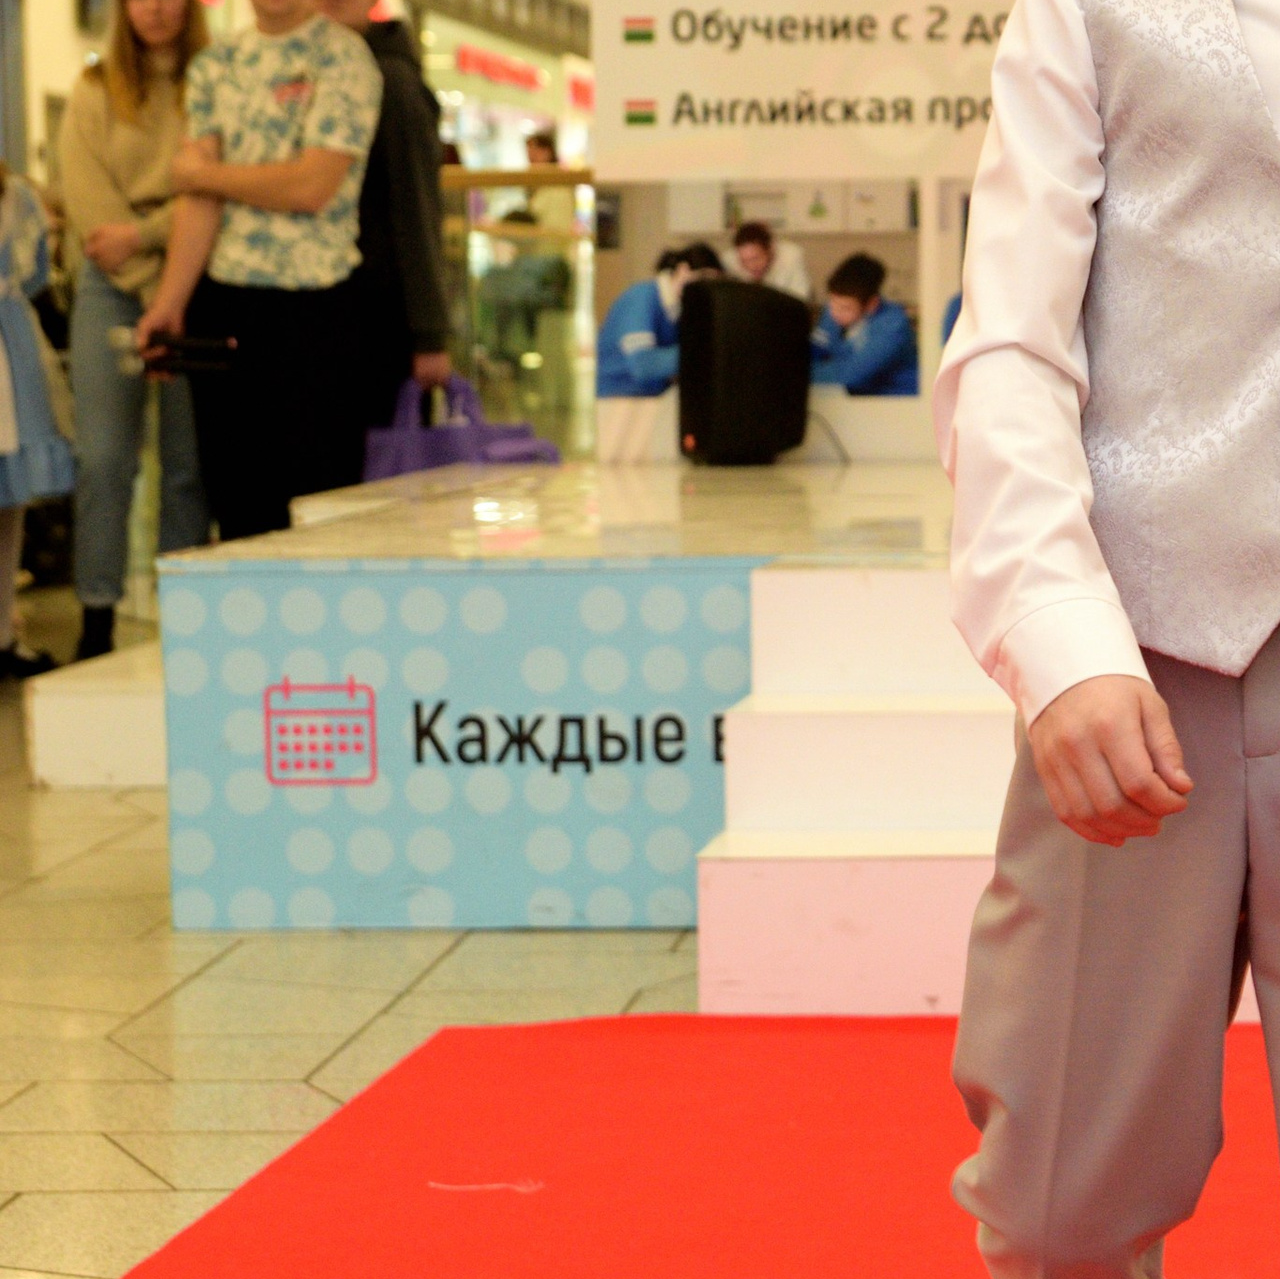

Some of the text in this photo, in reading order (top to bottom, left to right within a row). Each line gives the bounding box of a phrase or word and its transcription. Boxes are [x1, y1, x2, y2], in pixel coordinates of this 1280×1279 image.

[671, 8, 878, 52] Обучение
[925, 5, 949, 43] 2
[672, 88, 914, 125] Английская
[411, 699, 687, 775] Каждые
